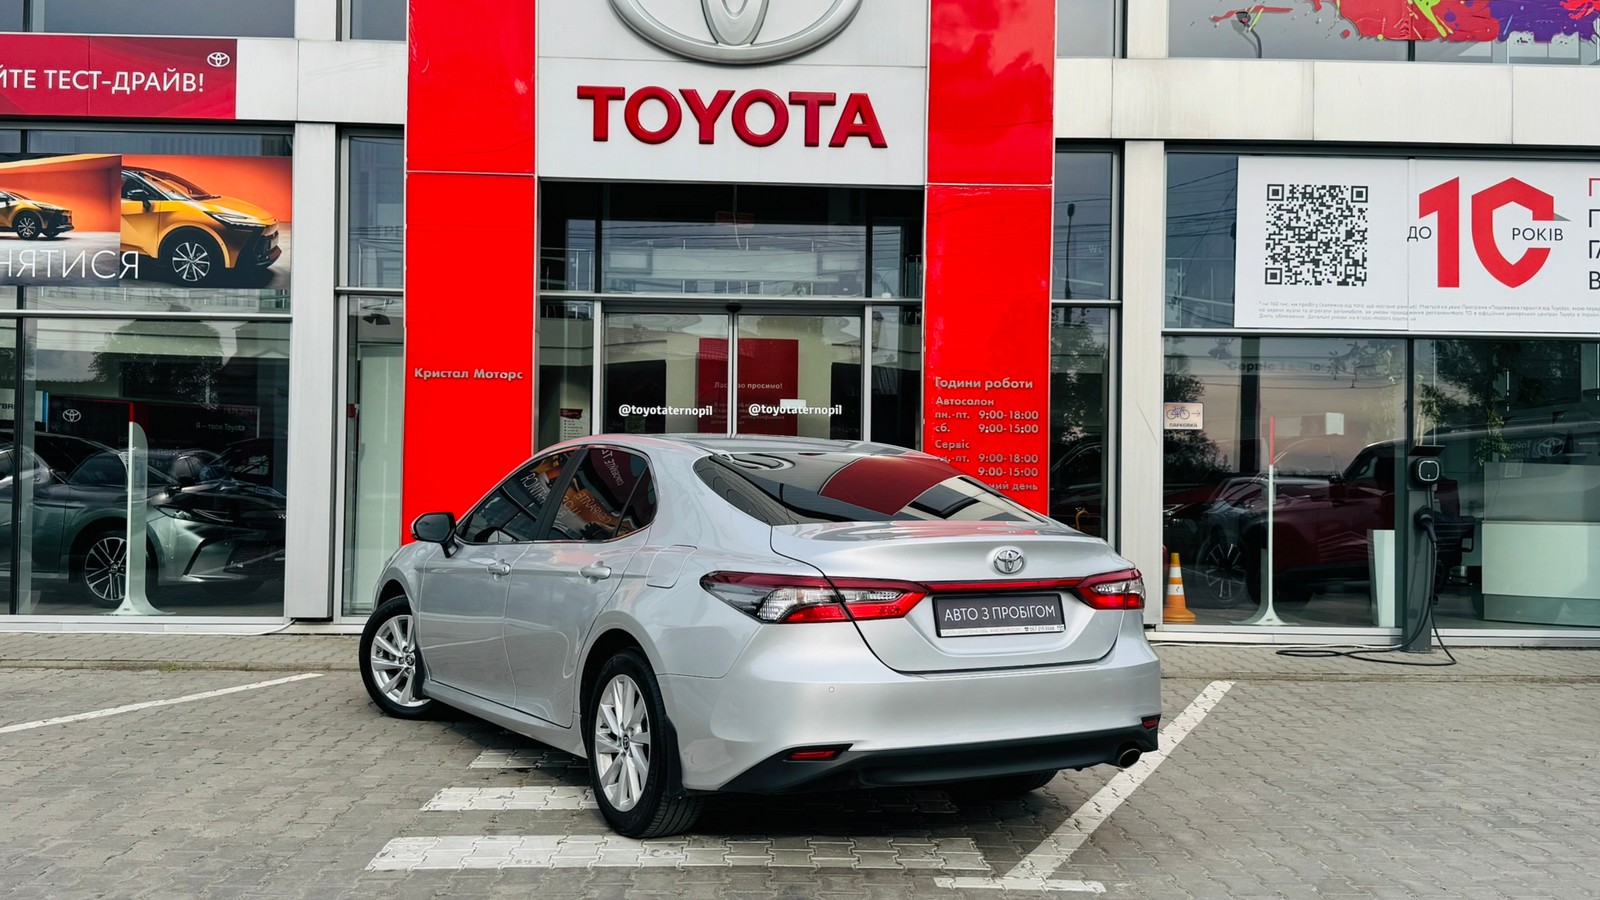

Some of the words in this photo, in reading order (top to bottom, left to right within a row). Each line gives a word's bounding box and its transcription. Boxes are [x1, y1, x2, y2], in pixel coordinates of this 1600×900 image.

[44, 68, 204, 94] ТЕСТ-ДРАЙВ!
[577, 85, 888, 148] TOYOTA
[1407, 226, 1432, 242] ДО
[1512, 227, 1564, 242] РОКІВ
[414, 368, 468, 380] Кристал
[474, 369, 523, 381] Моторс
[934, 377, 981, 390] Години
[985, 378, 1033, 390] роботи
[936, 396, 994, 406] Автосалон
[618, 404, 713, 418] @toyotaternopil
[748, 404, 842, 417] @toyotaternopil
[934, 424, 950, 432] сб.
[934, 440, 970, 450] Сервіс
[1012, 482, 1038, 491] день
[944, 608, 978, 622] АВТО
[992, 605, 1056, 620] ПРОБІГОМ
